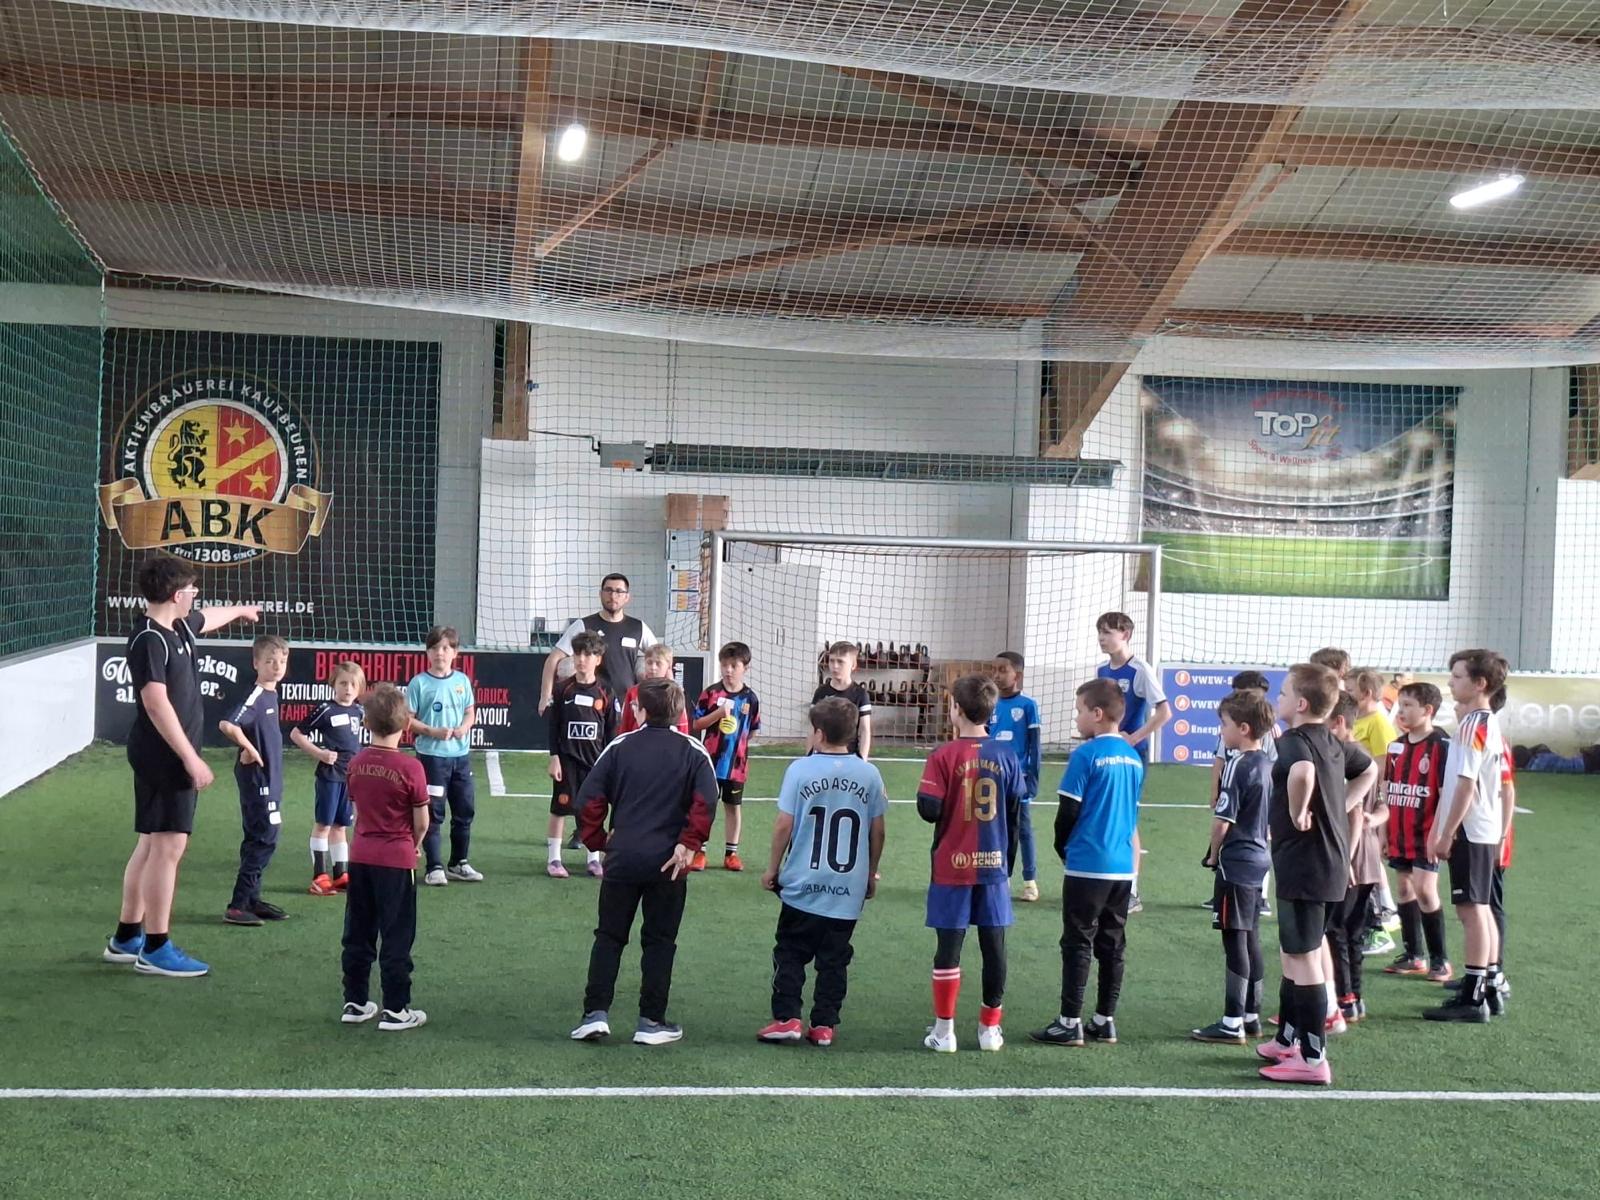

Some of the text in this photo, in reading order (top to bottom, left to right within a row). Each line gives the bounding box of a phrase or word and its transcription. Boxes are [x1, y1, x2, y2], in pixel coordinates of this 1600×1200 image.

[125, 379, 307, 480] AKTIENBRAUEREI KAUFBEUREN
[160, 499, 275, 546] ABK
[194, 548, 231, 562] 1308
[233, 548, 258, 561] SINCE
[475, 707, 511, 727] AYOUT,
[569, 724, 596, 738] AIG
[800, 777, 870, 805] IAGO ASPAS
[962, 777, 998, 822] 19
[808, 805, 861, 874] 10
[804, 883, 850, 896] ABANCA
